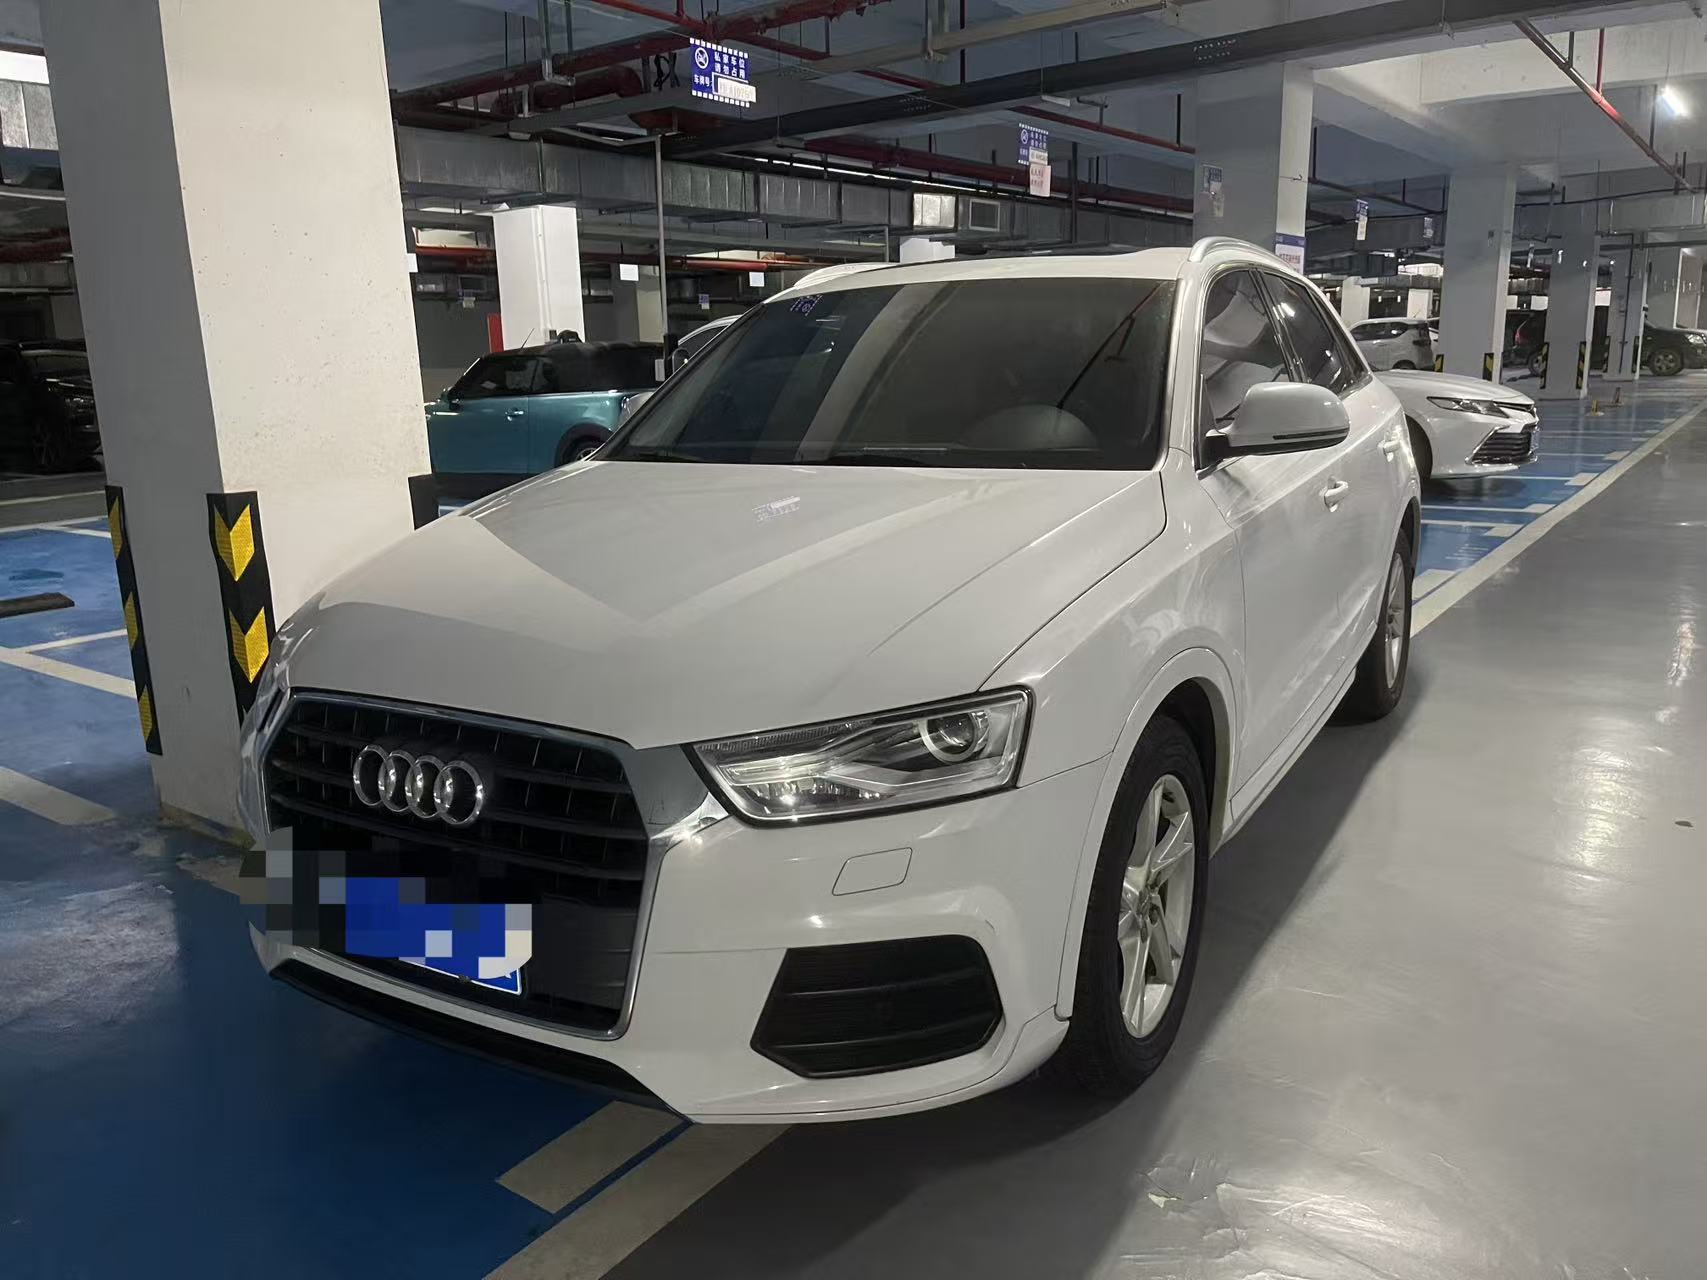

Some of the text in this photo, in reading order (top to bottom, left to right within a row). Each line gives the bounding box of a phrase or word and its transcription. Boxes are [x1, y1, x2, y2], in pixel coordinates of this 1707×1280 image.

[714, 51, 745, 69] 私家车位
[714, 62, 746, 80] 请勿占用
